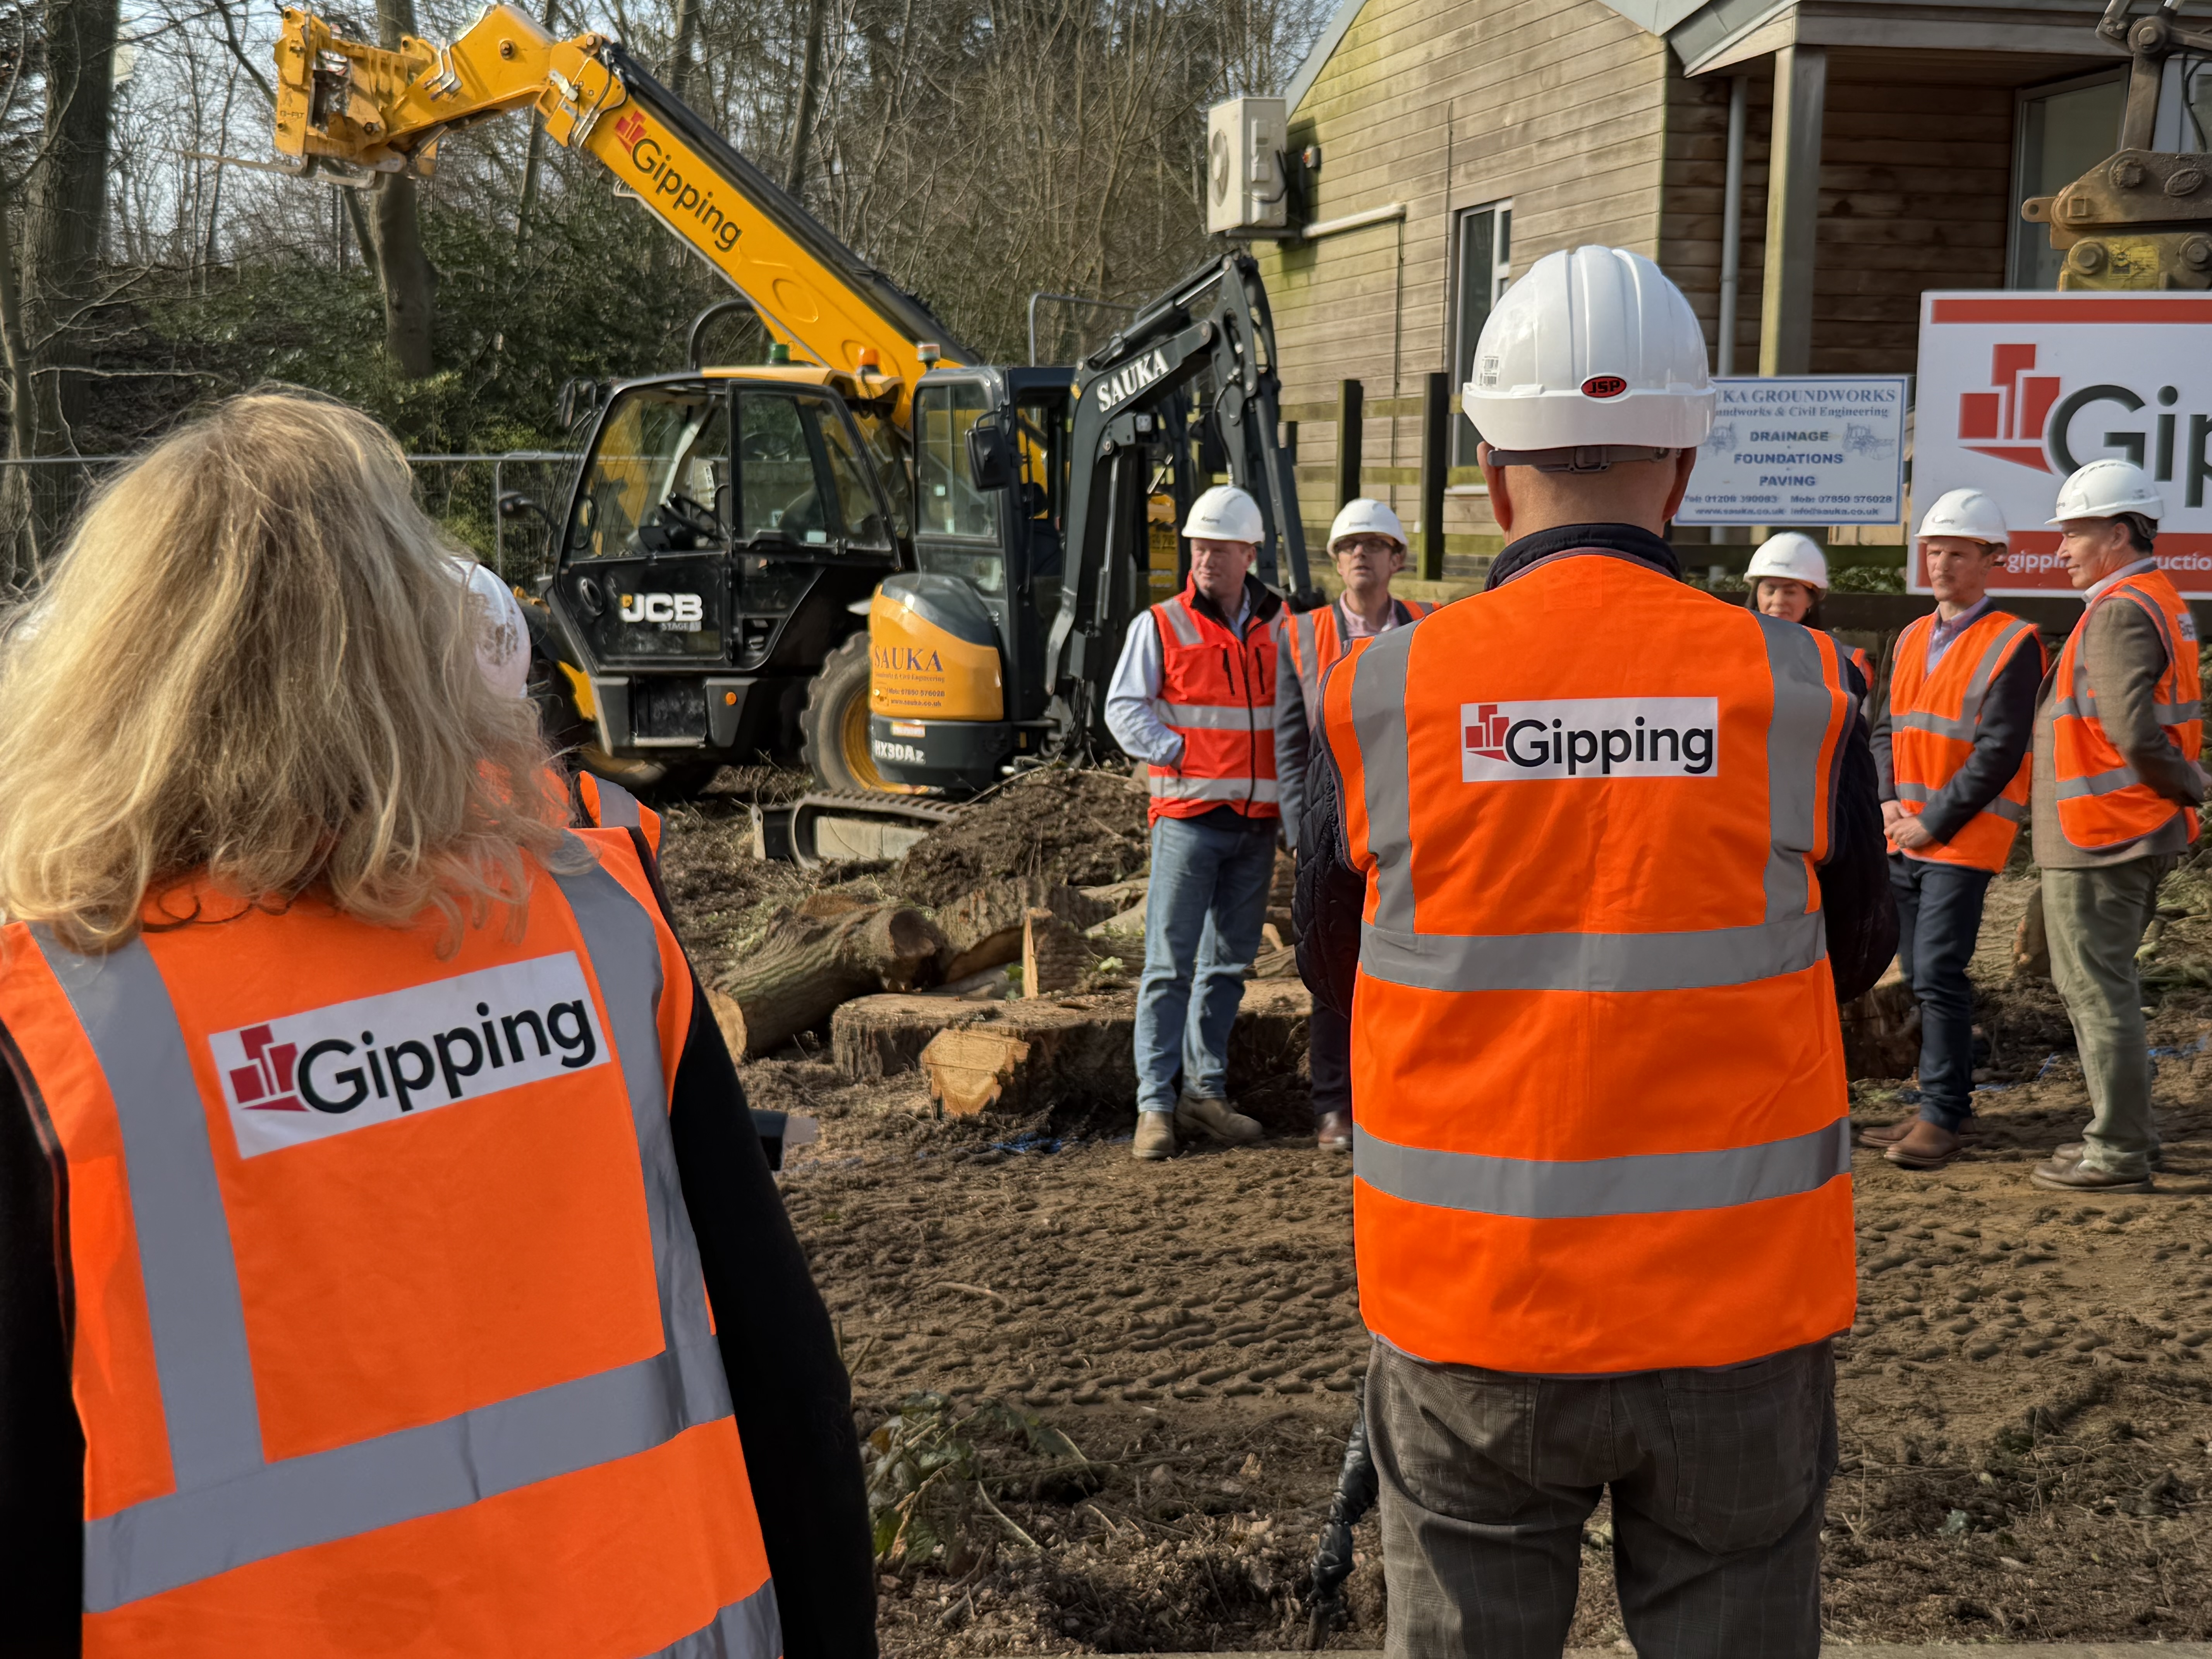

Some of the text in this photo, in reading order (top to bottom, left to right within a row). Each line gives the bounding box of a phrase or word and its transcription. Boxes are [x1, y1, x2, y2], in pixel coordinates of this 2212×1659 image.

[632, 138, 743, 253] Gipping
[1096, 348, 1170, 413] SAUKA
[1588, 380, 1620, 393] JSP
[1752, 390, 1896, 403] GROUNDWORKS
[1775, 407, 1784, 416] &
[1789, 407, 1815, 416] Civil
[1820, 407, 1888, 418] Engineering
[1750, 431, 1829, 441] DRAINAGE
[1734, 454, 1843, 464] FOUNDATIONS
[1759, 476, 1815, 486] PAVING
[622, 593, 703, 622] JCB
[875, 645, 943, 672] SAUKA
[1506, 716, 1713, 775] Gipping
[298, 999, 597, 1114] Gipping
